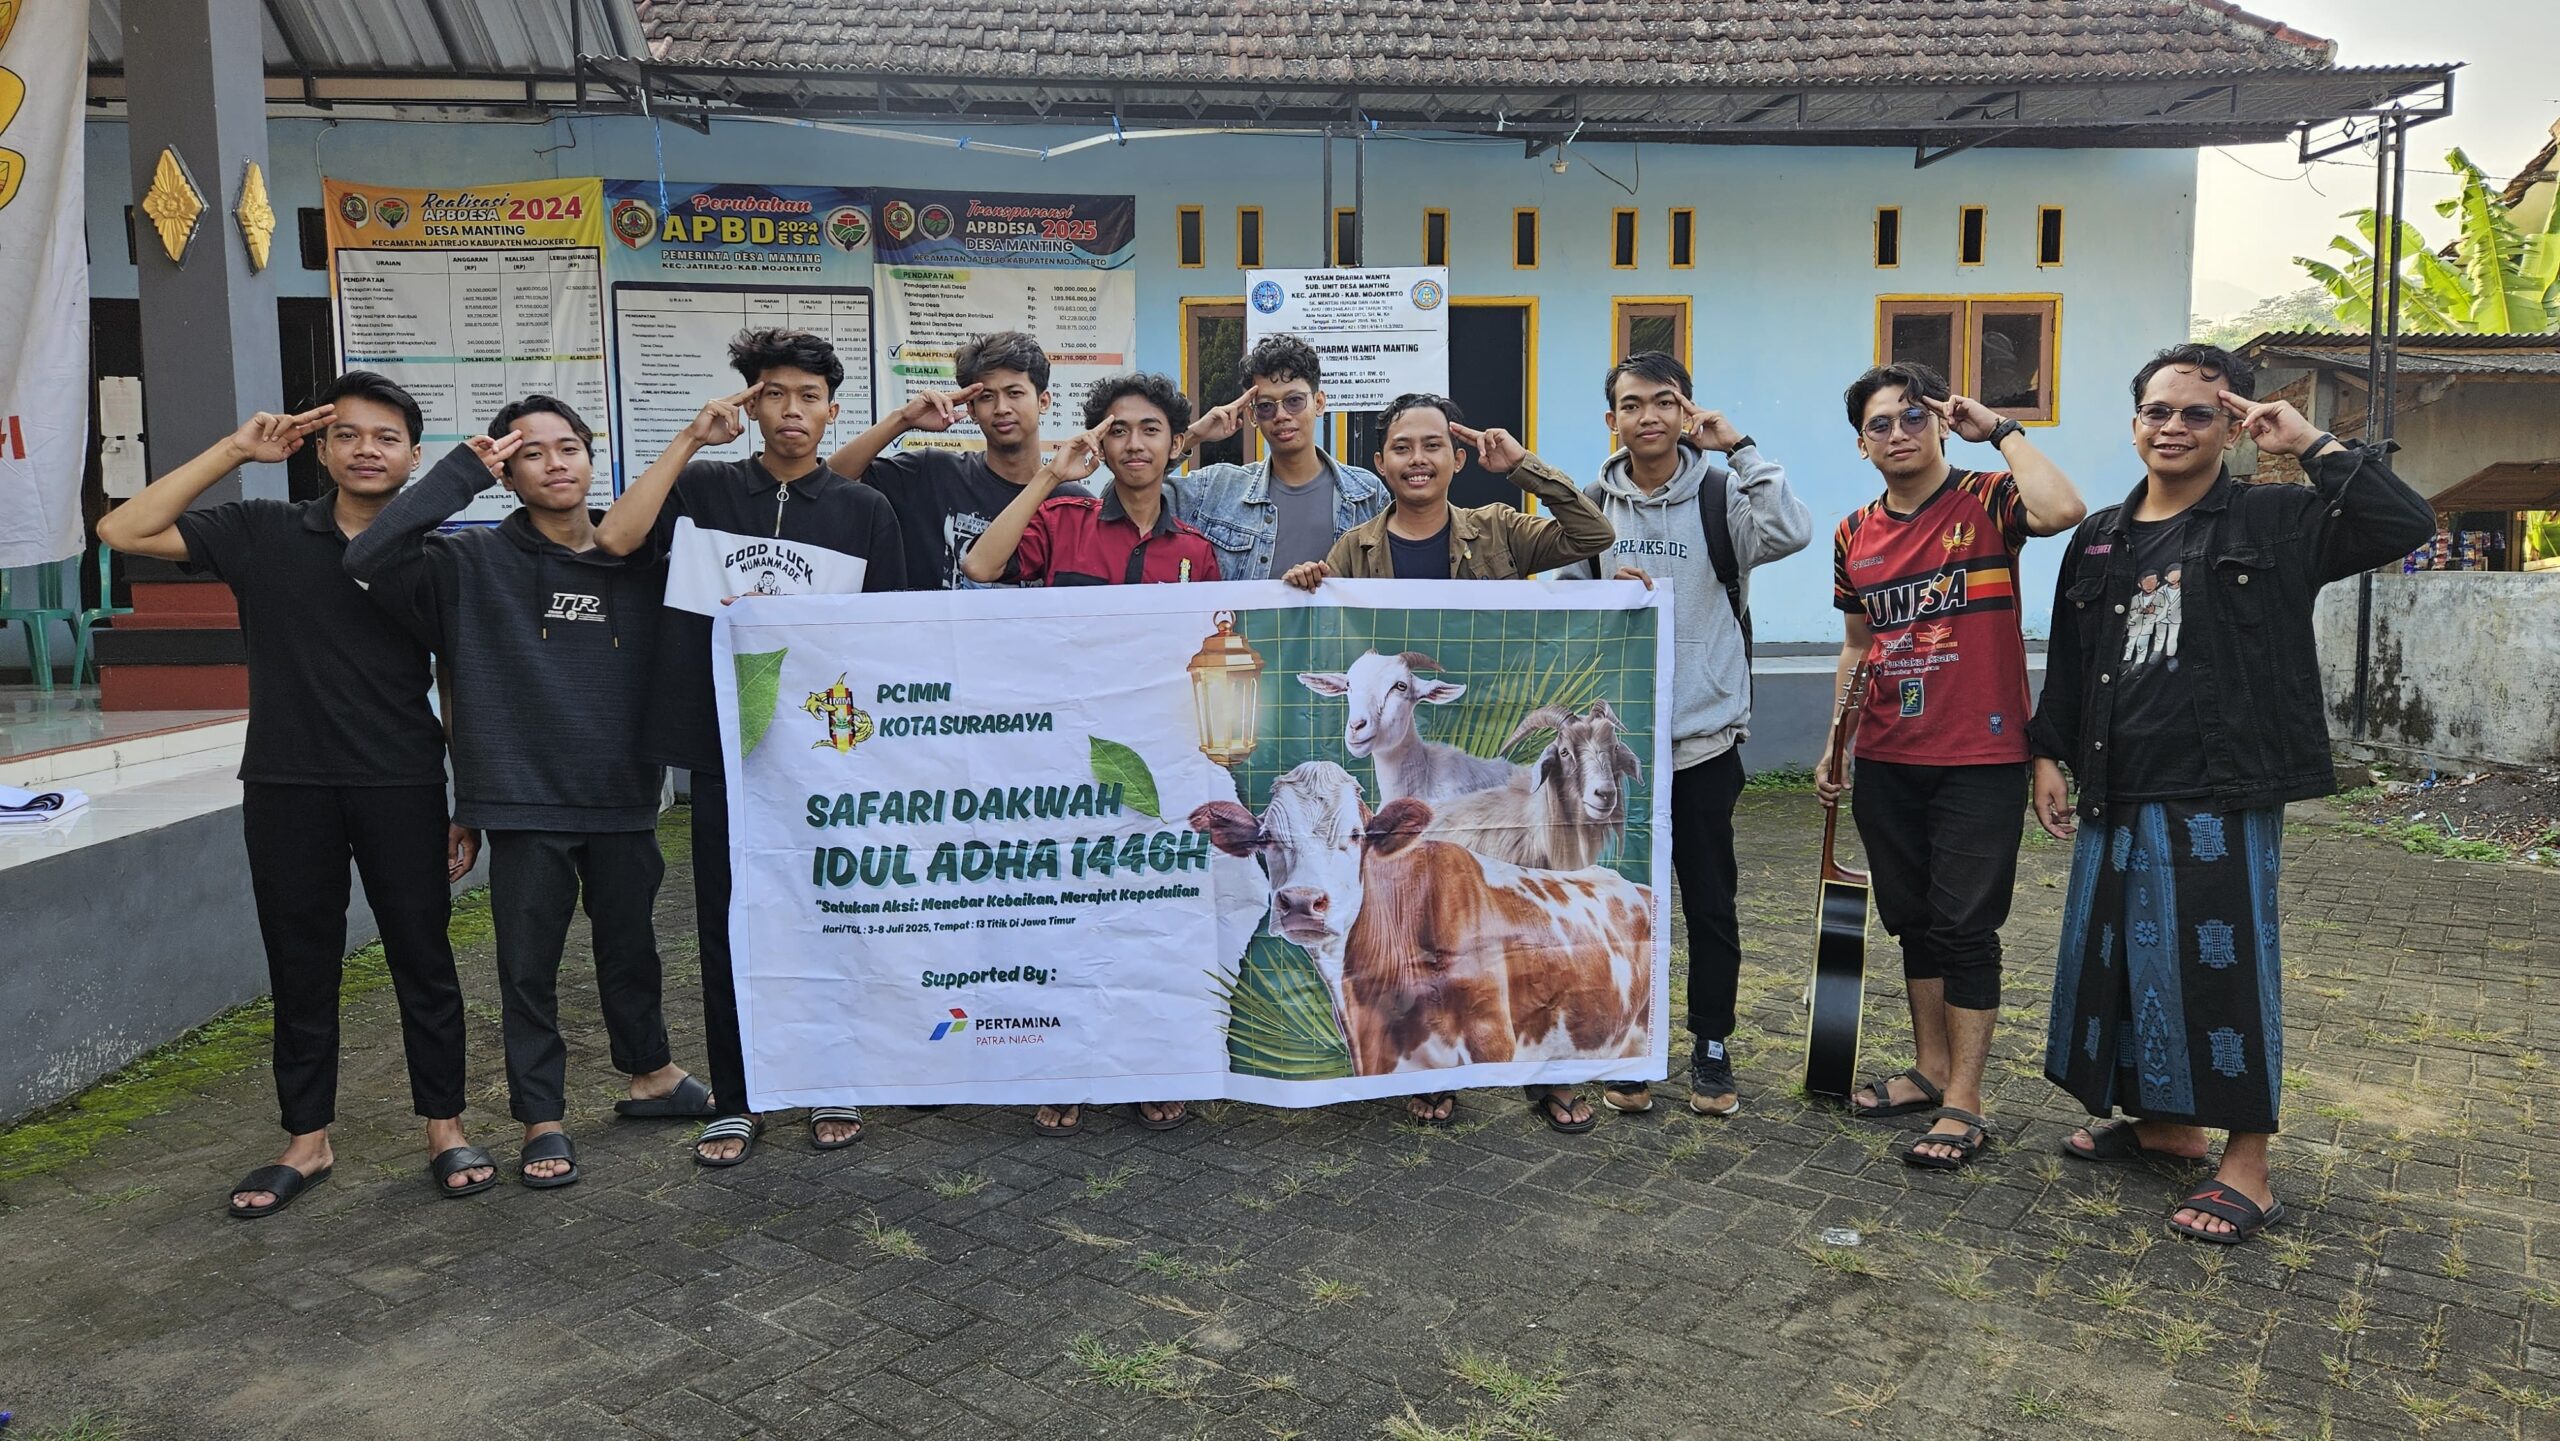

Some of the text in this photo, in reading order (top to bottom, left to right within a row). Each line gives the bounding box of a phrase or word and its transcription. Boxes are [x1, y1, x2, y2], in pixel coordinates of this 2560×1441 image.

[421, 192, 511, 209] Realisasi
[423, 196, 583, 222] APBDESA 2024
[691, 194, 813, 214] Perubahan
[425, 225, 526, 236] DESA MANTING
[661, 215, 819, 244] APBD 2024
[965, 219, 1097, 240] APBDESA 2025
[470, 239, 522, 247] KABUPATEN
[523, 238, 576, 246] MOJOKERTO
[965, 237, 1073, 253] DESA MANTING
[662, 250, 822, 263] PEMERINTA DESA MANTING
[913, 254, 965, 262] KECAMATAN
[968, 256, 1005, 264] JATIREJO
[1007, 257, 1055, 265] KABUPATEN
[903, 272, 954, 280] PENDAPATAN
[1316, 344, 1419, 354] DHARMA WANITA MANTING
[724, 543, 814, 586] GOOD LUCK
[552, 592, 600, 613] TR
[829, 696, 853, 706] IMM
[879, 712, 1053, 738] KOTA SURABAYA
[806, 782, 1125, 828] SAFARI DAKWAH
[812, 831, 1211, 888] IDUL ADHA 1446H
[882, 898, 920, 914] Aksi:
[921, 895, 984, 911] Menebar
[986, 892, 1058, 909] Kebaikan,
[1060, 888, 1117, 906] Merajut
[1119, 884, 1200, 903] Kepedulian
[867, 924, 885, 935] 3-8
[886, 923, 905, 934] Juli
[905, 922, 932, 934] 2025,
[933, 920, 970, 933] Tempat
[976, 919, 985, 929] 13
[986, 917, 1007, 929] Titik
[1009, 916, 1019, 928] Di
[1020, 916, 1047, 928] Jawa
[1048, 915, 1076, 927] Timur
[921, 965, 1020, 989] Supported
[1023, 965, 1048, 986] By
[975, 1015, 1061, 1031] PERTAMINA
[976, 1033, 1045, 1047] PATRA NIAGA
